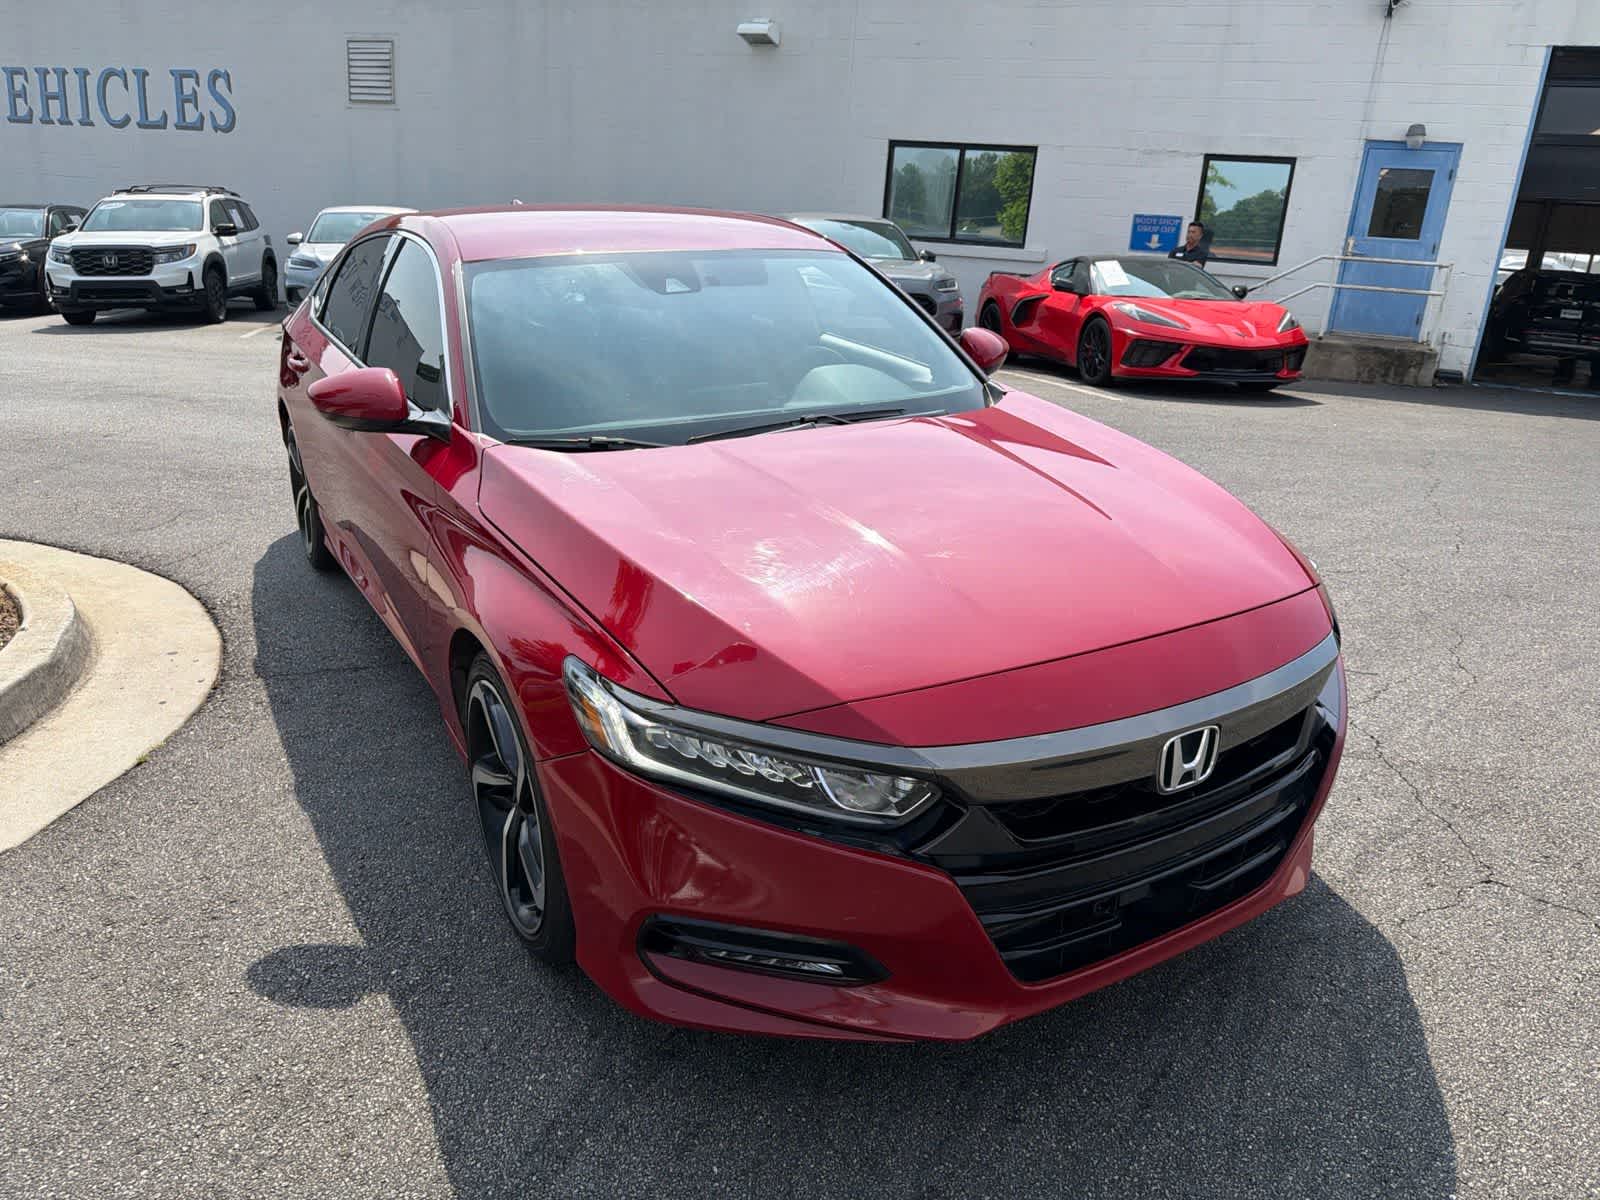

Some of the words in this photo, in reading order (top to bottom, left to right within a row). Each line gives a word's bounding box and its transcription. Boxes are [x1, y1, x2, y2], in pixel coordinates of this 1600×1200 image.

[2, 66, 236, 133] EHICLES
[1135, 216, 1157, 225] BODY
[1159, 217, 1181, 226] SHOP
[1137, 224, 1159, 232] DROP
[1160, 225, 1177, 233] OFF
